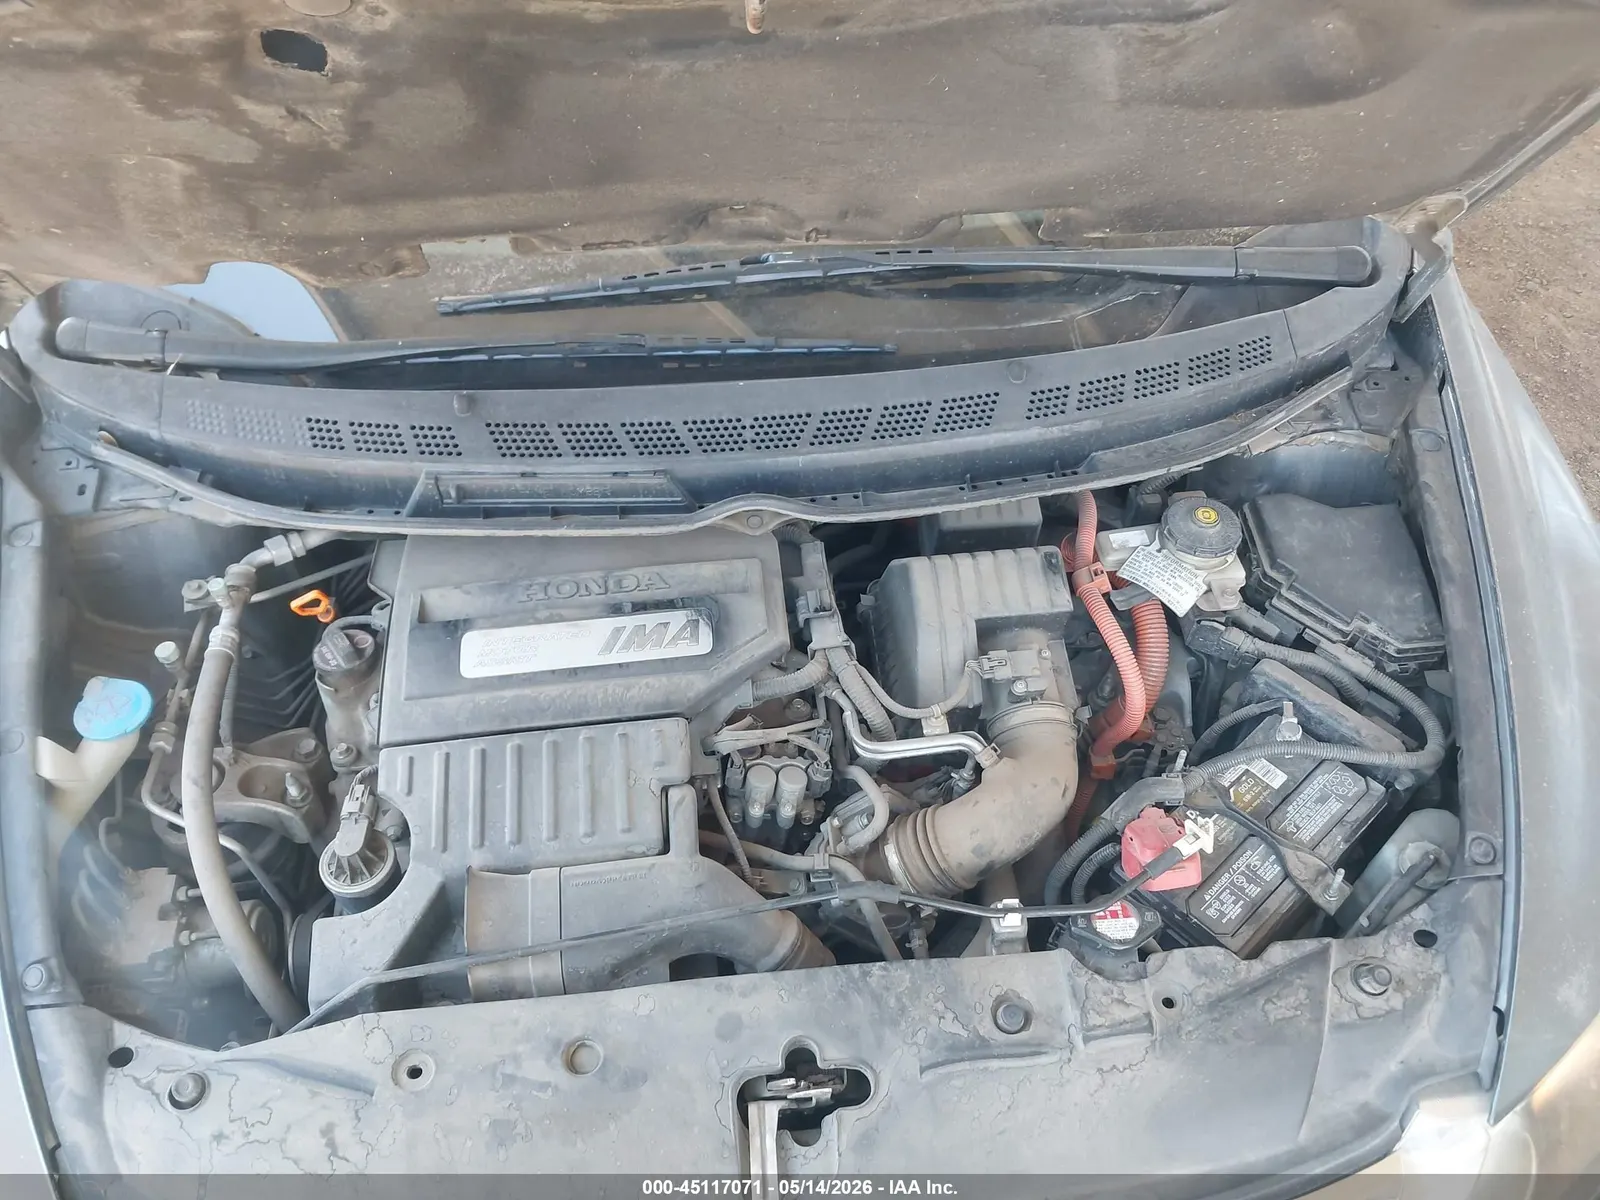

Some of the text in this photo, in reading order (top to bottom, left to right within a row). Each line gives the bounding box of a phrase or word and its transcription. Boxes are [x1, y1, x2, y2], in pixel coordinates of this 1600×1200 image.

[1160, 550, 1199, 580] INFORMATION
[518, 571, 670, 603] HONDA
[597, 617, 701, 656] IMA
[1237, 776, 1255, 794] GOLD
[1207, 871, 1231, 896] DANGER
[1231, 848, 1253, 871] POISON
